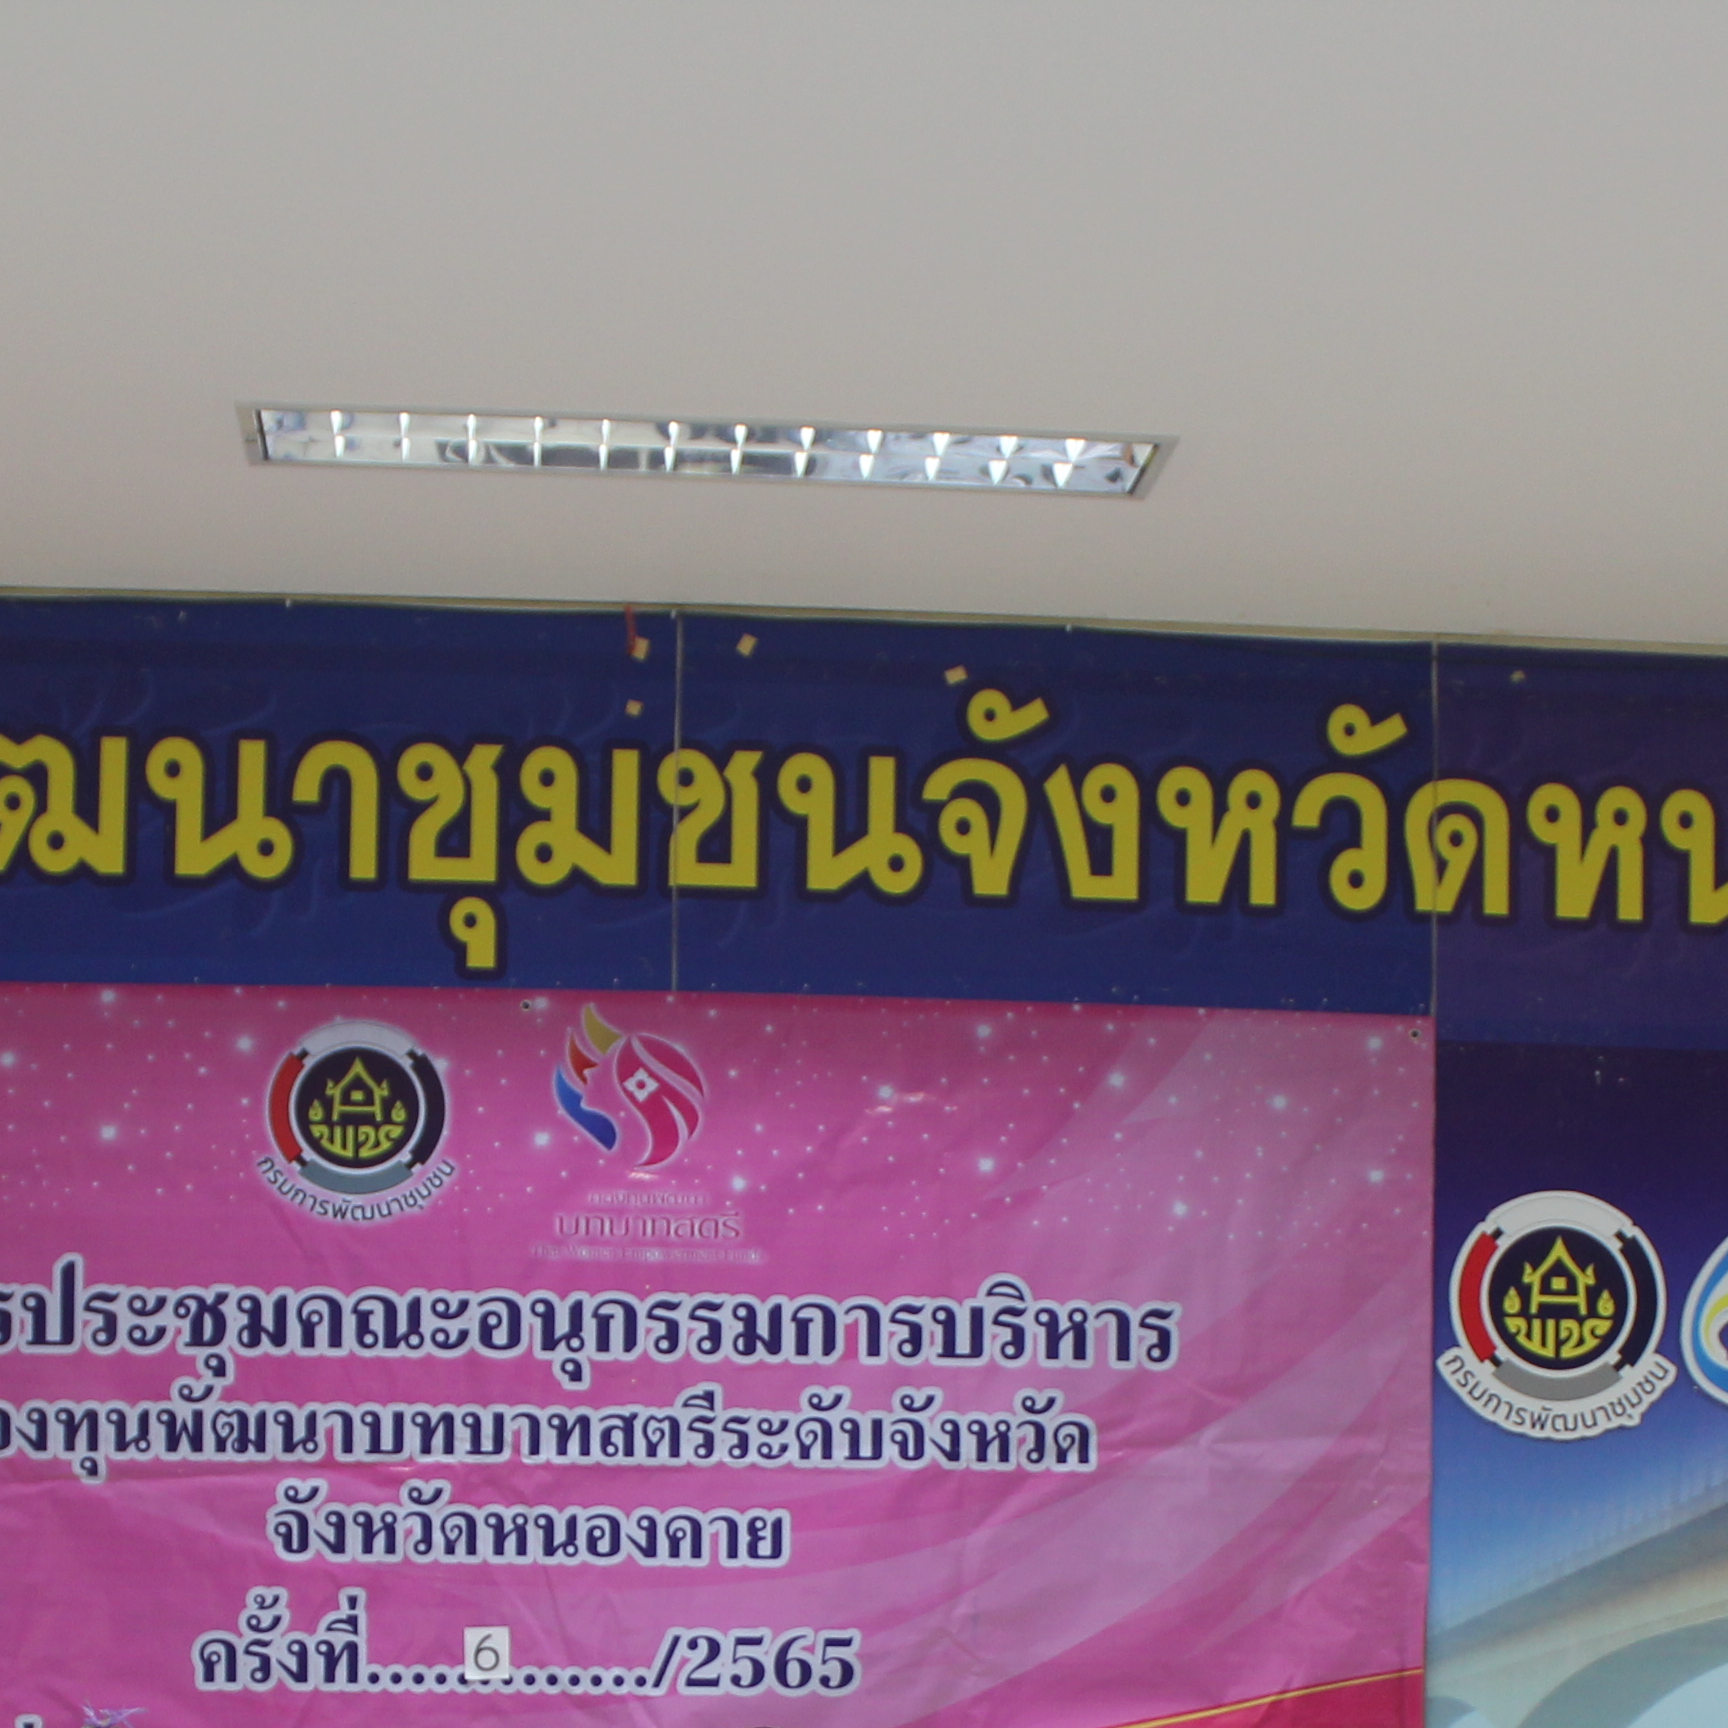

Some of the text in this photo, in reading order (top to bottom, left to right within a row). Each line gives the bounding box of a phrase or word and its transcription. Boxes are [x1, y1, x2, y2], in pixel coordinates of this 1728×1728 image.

[257, 1154, 456, 1222] กรมการพัฒนาชุมชน
[1445, 1354, 1669, 1433] กรมการพัฒนาชุมชน
[271, 1484, 786, 1561] จังหวัดหนองคาย
